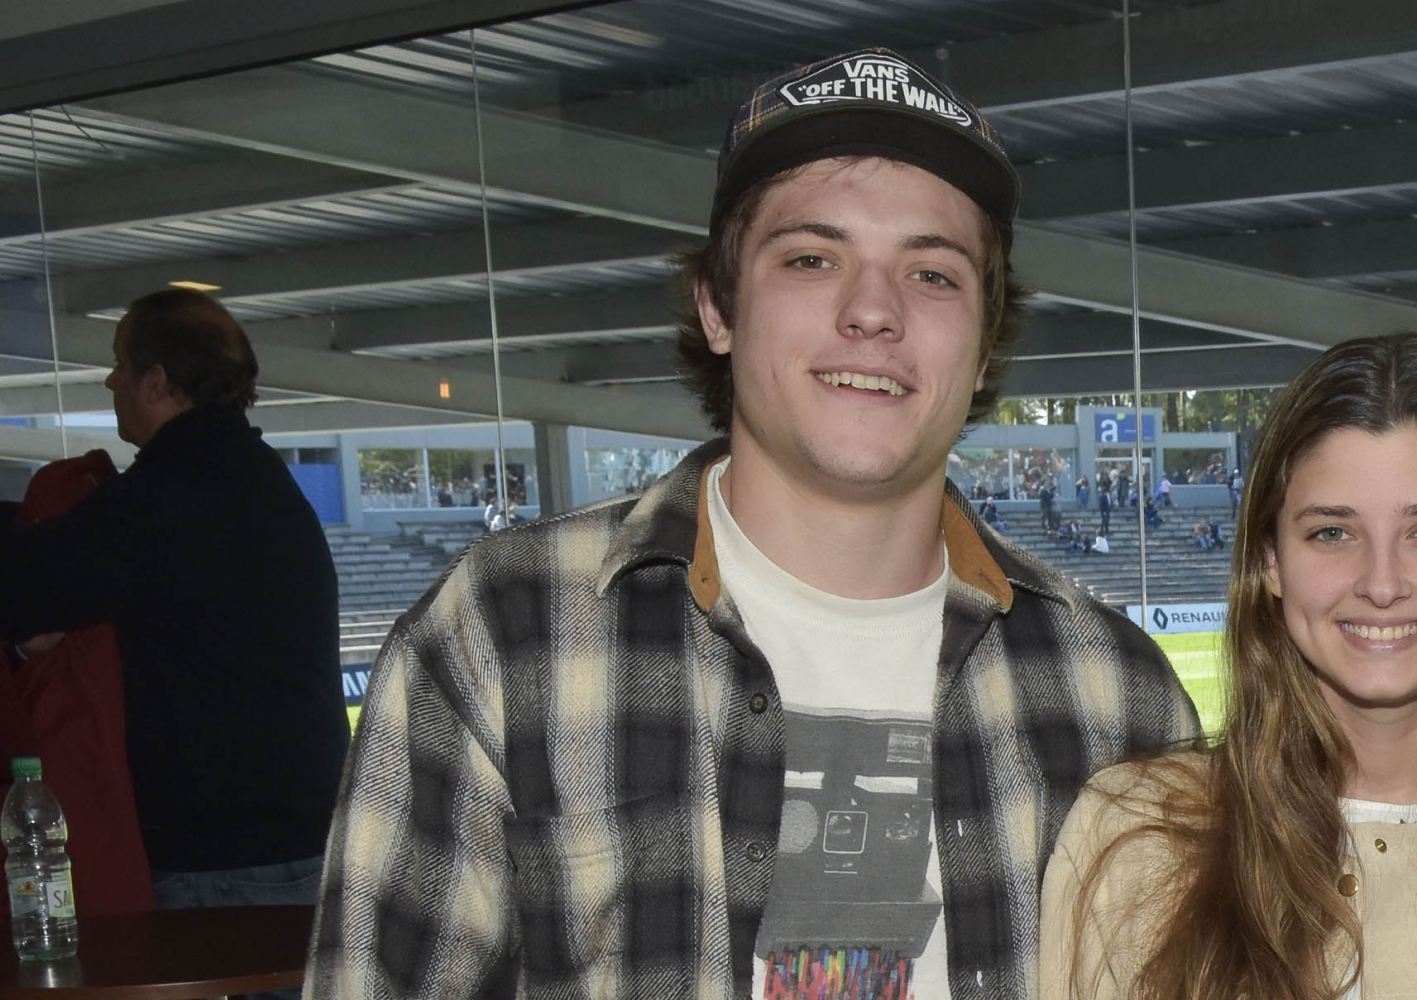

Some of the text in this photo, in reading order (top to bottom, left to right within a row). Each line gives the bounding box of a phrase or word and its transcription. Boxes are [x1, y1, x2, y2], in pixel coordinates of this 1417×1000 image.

[843, 60, 909, 83] VANS
[850, 78, 900, 103] THE
[1101, 419, 1118, 442] a
[1171, 611, 1225, 624] RENAU
